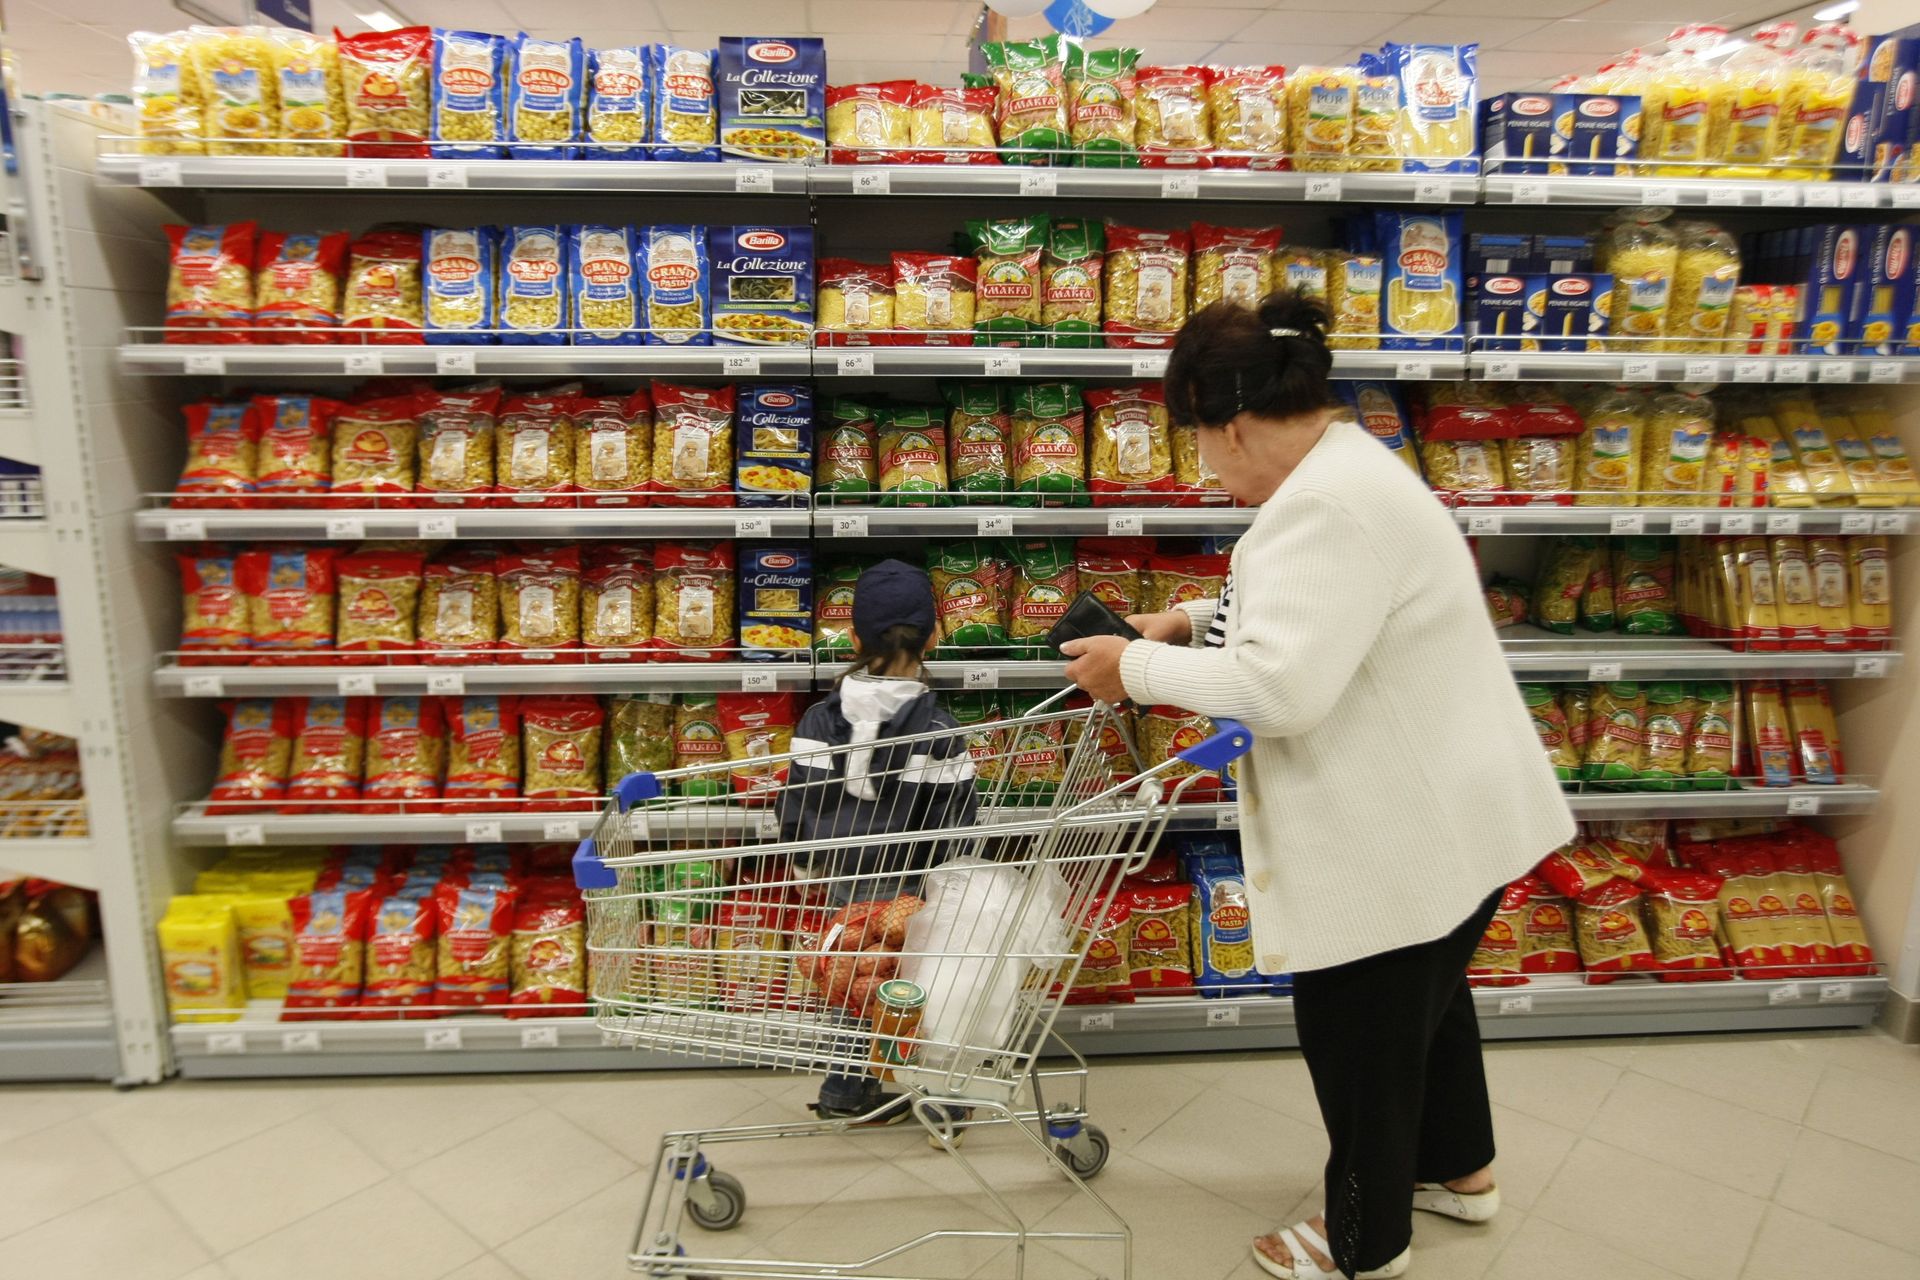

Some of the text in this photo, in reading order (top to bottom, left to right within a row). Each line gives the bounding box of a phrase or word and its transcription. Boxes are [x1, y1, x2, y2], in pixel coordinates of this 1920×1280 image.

[759, 47, 791, 58] Barilla
[443, 70, 491, 86] GRAND
[522, 70, 570, 86] GRAND
[726, 68, 819, 88] La Collezione
[529, 84, 559, 94] PASTA
[748, 235, 780, 246] Barilla
[1402, 251, 1447, 267] GRAND
[431, 257, 479, 273] GRAND
[583, 261, 628, 276] GRAND
[716, 256, 807, 275] La Collezione
[441, 271, 468, 281] PASTA
[592, 274, 621, 284] PASTA
[650, 266, 697, 281] GRAND
[659, 279, 688, 288] PASTA
[987, 285, 1029, 296] MAKFA
[766, 396, 791, 405] Barilla
[752, 412, 811, 427] Collezione
[1034, 445, 1075, 454] MAKFA
[897, 451, 936, 464] MAKFA
[767, 557, 791, 565] Barilla
[754, 573, 812, 588] Collezione
[825, 607, 854, 618] MAK
[1025, 605, 1066, 615] MAKFA
[679, 742, 720, 753] MAKFA
[1212, 907, 1249, 920] GRAND
[1220, 920, 1243, 928] PASTA
